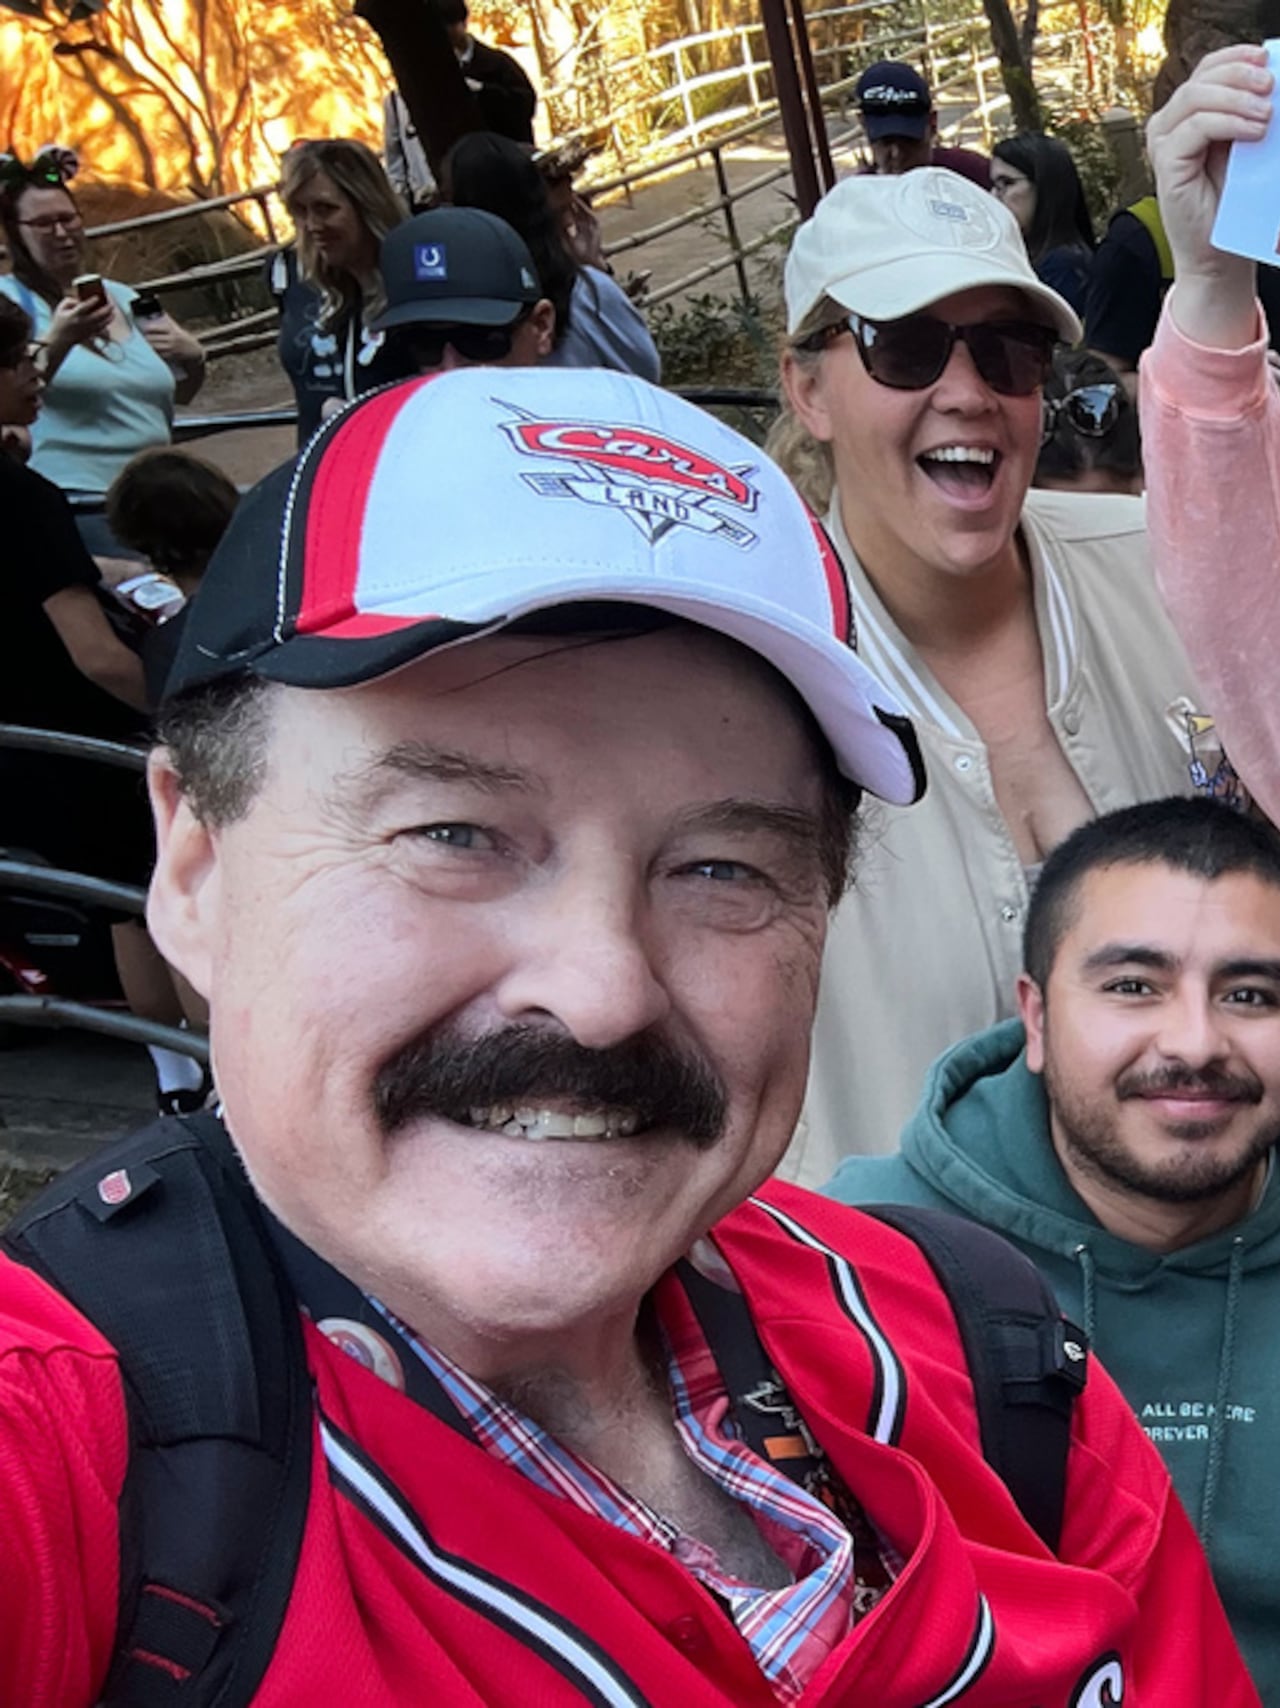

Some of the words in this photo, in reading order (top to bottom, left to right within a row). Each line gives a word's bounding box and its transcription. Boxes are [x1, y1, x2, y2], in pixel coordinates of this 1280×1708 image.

[538, 426, 739, 501] Cars
[603, 486, 690, 522] LAND
[1142, 1403, 1176, 1417] ALL
[1179, 1402, 1204, 1417] BE
[1143, 1424, 1209, 1441] OREVER
